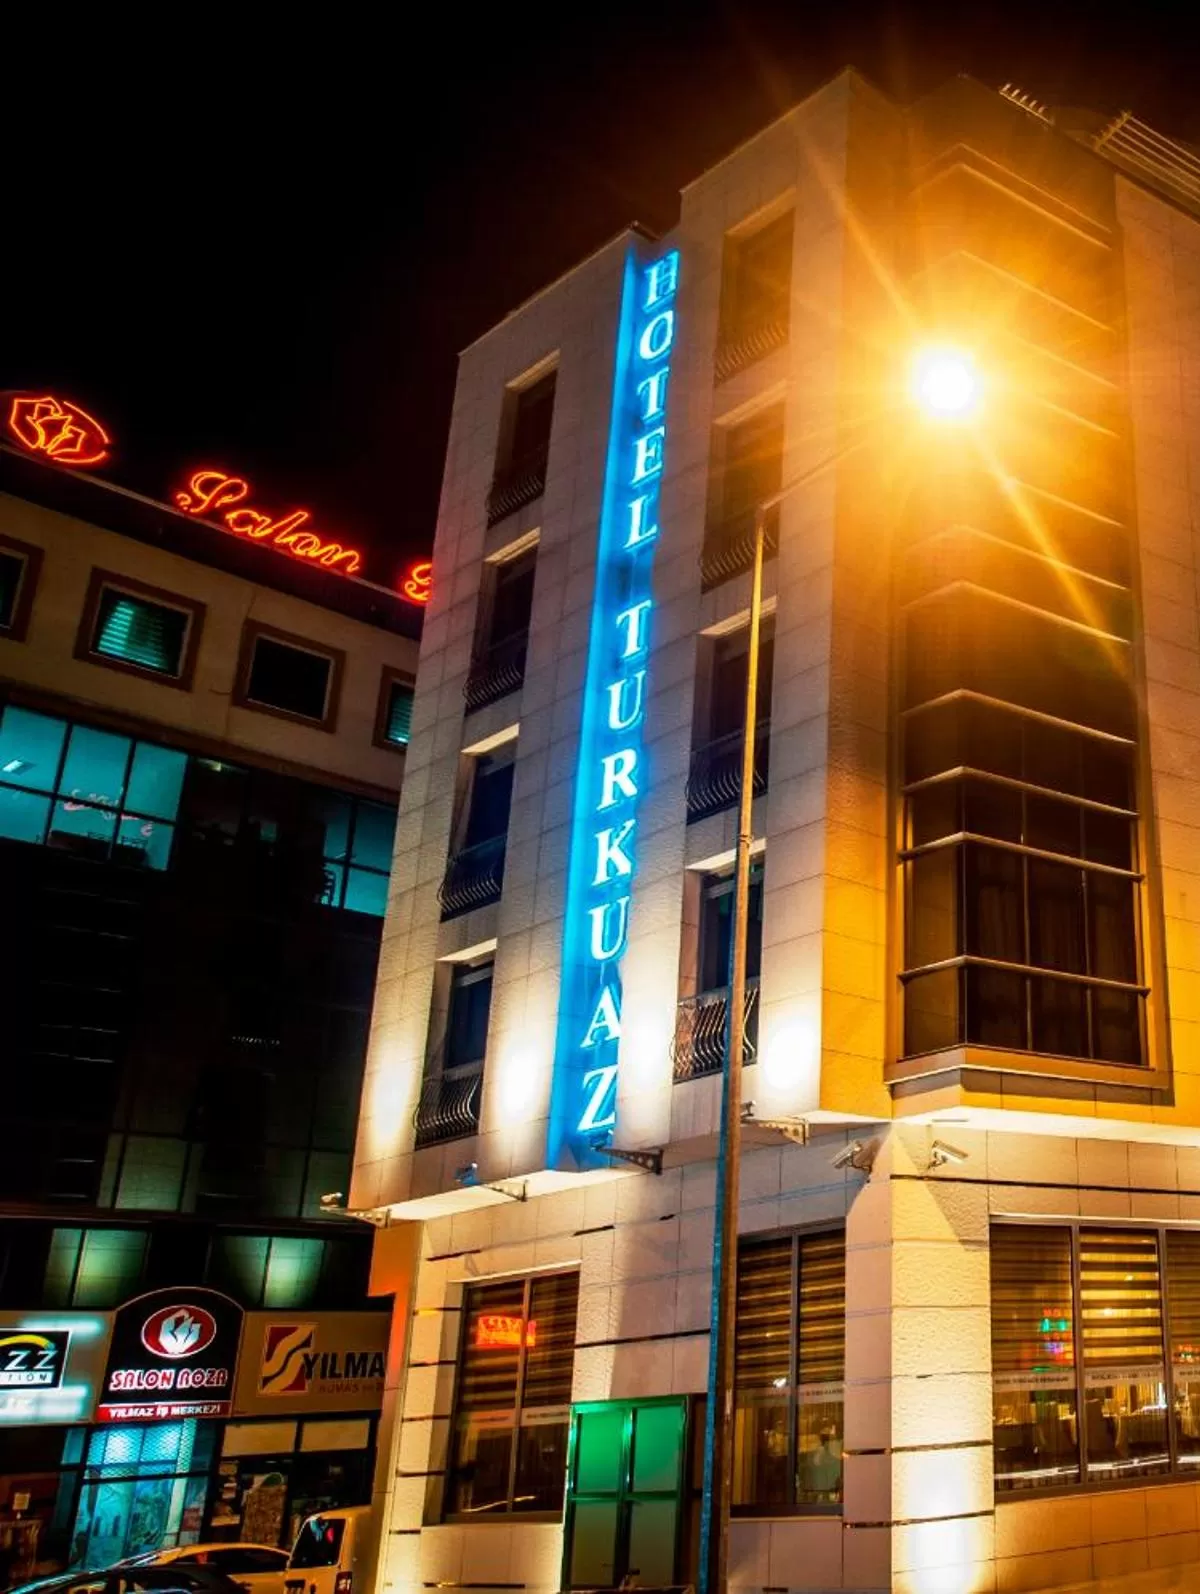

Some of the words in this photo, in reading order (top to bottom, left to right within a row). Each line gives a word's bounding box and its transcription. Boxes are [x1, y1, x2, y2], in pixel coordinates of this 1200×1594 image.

[624, 249, 680, 550] HOTEL
[176, 470, 361, 573] Salon
[576, 599, 653, 1134] TURKUAZ
[109, 1369, 175, 1392] SALON
[110, 1407, 154, 1418] YILMAZ
